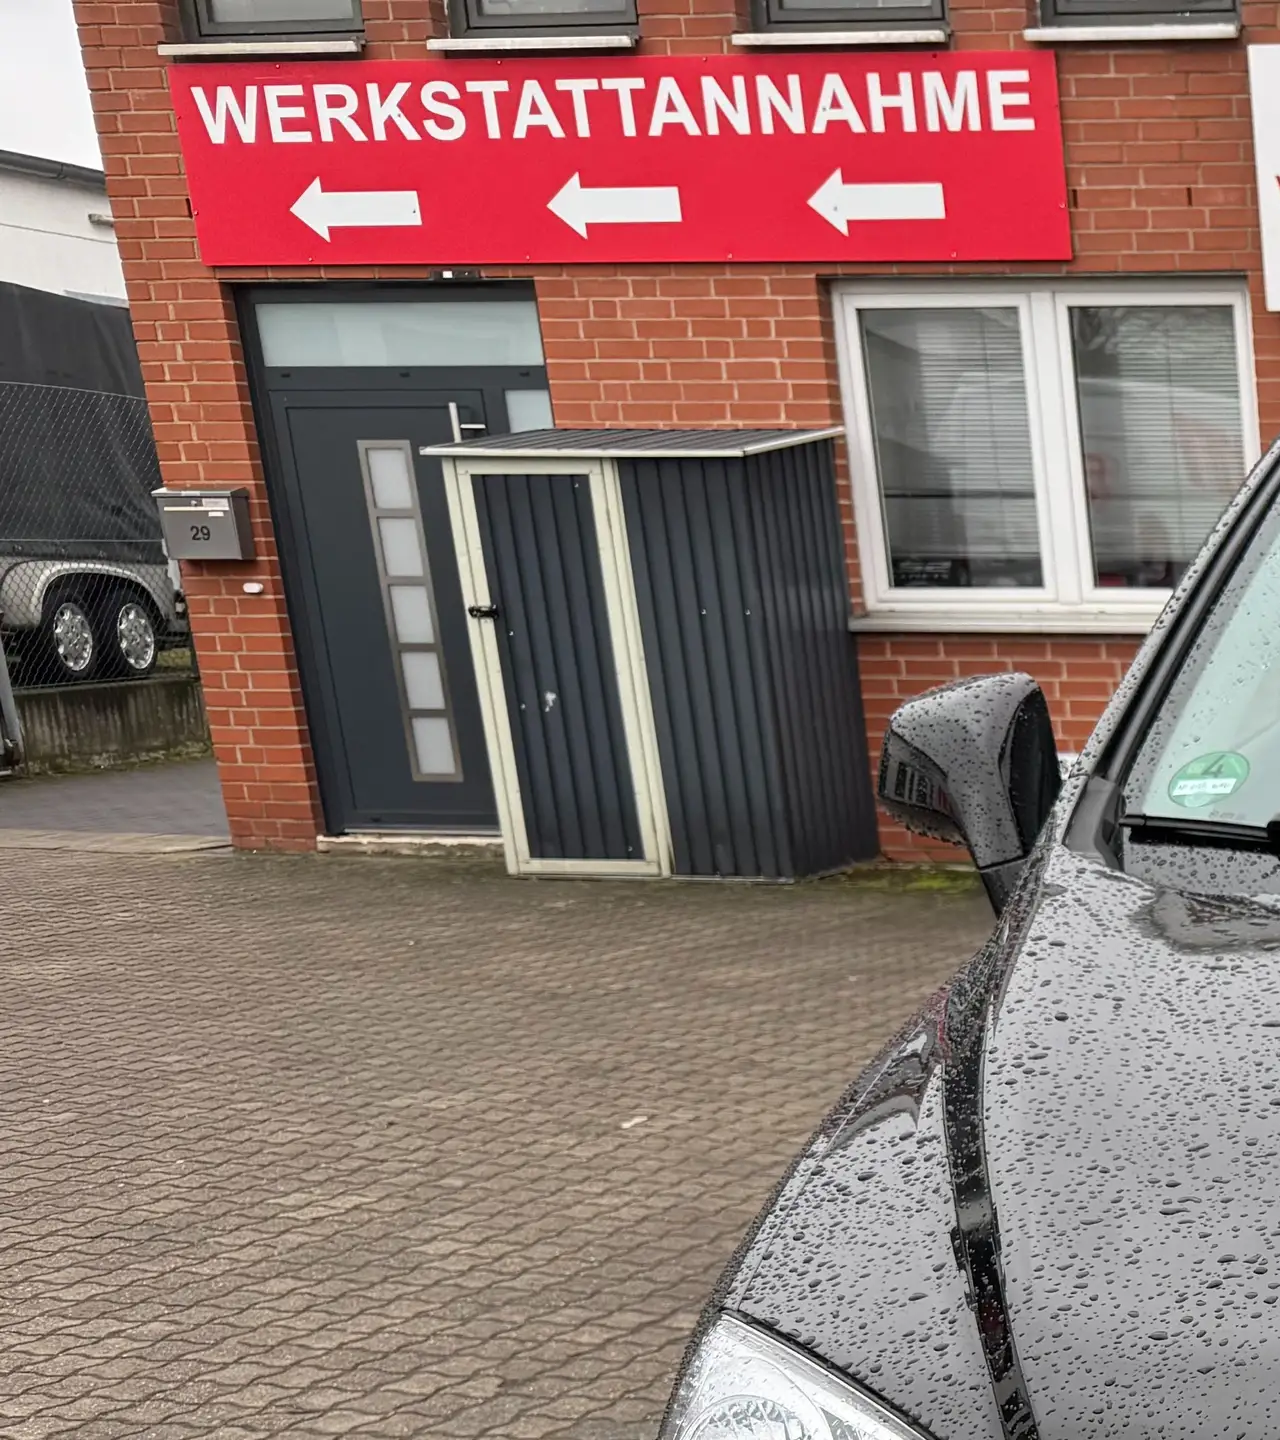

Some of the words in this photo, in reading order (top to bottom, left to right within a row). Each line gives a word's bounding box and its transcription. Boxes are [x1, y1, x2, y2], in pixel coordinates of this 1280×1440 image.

[192, 69, 1036, 145] WERKSTATTANNAHME
[190, 525, 211, 541] 29
[1199, 754, 1226, 778] 4
